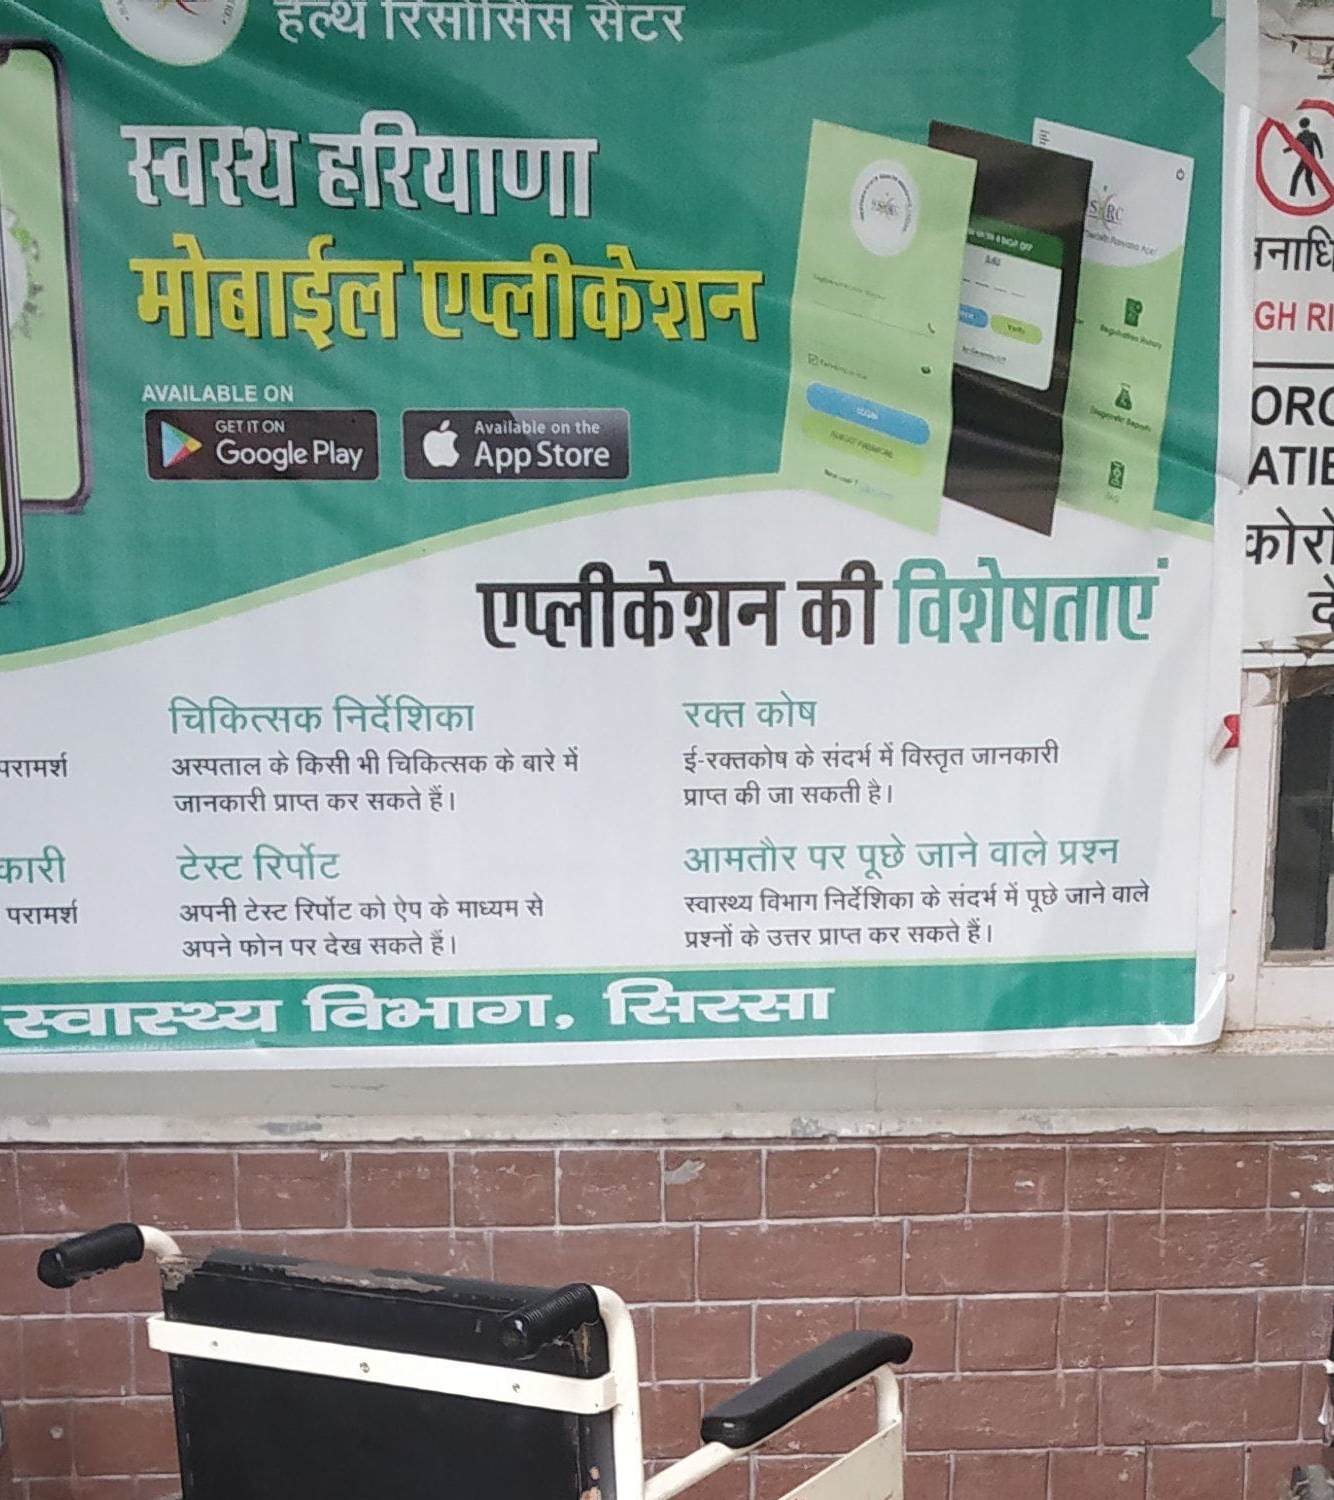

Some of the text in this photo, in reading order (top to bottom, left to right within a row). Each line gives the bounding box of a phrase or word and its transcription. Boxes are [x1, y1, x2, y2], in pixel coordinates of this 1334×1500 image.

[120, 109, 599, 218] स्वस्थ हरियाणा
[129, 233, 764, 351] मोबाईल एप्लीकेशन
[1254, 299, 1296, 332] GH
[142, 384, 293, 403] AVAILABLE ON
[215, 419, 285, 434] GET IT ON
[474, 419, 600, 436] Available on the
[215, 439, 363, 473] Google Play
[474, 442, 611, 473] App Store
[476, 557, 1168, 648] एप्लीकेशन की विशेषताएं
[168, 694, 474, 734] चिकित्सक निर्देशिका
[682, 690, 817, 728] रक्त कोष
[172, 746, 578, 776] अस्पताल के किसी भी चिकित्सक के बारे में
[795, 744, 814, 768] के
[822, 742, 871, 768] संदर्भ
[878, 742, 893, 766] में
[901, 742, 964, 773] विस्तृत
[971, 739, 1059, 764] जानकारी
[173, 786, 421, 813] जानकारी प्राप्त कर सकते
[683, 778, 861, 806] प्राप्त की जा सकती
[176, 845, 242, 881] टेस्ट
[684, 830, 1119, 879] आमतौर पर पूछे जाने वाले प्रश्न
[6, 899, 77, 924] परामर्श
[180, 897, 236, 922] अपनी
[244, 897, 287, 921] टेस्ट
[358, 895, 386, 920] को
[429, 894, 449, 918] के
[456, 900, 518, 918] माध्यम
[525, 893, 543, 916] से
[684, 879, 1149, 913] स्वास्थ्य विभाग निर्देशिका के संदर्भ में पूछे जाने वाले
[183, 930, 422, 957] अपने फोन पर देख सकते
[685, 924, 732, 948] प्रश्नों
[740, 924, 759, 947] के
[766, 929, 811, 946] उत्तर
[818, 928, 861, 945] प्राप्त
[868, 927, 900, 944] कर
[907, 919, 960, 943] सकते
[1, 1000, 278, 1037] स्वास्थ्य
[604, 978, 836, 1027] सिरसा
